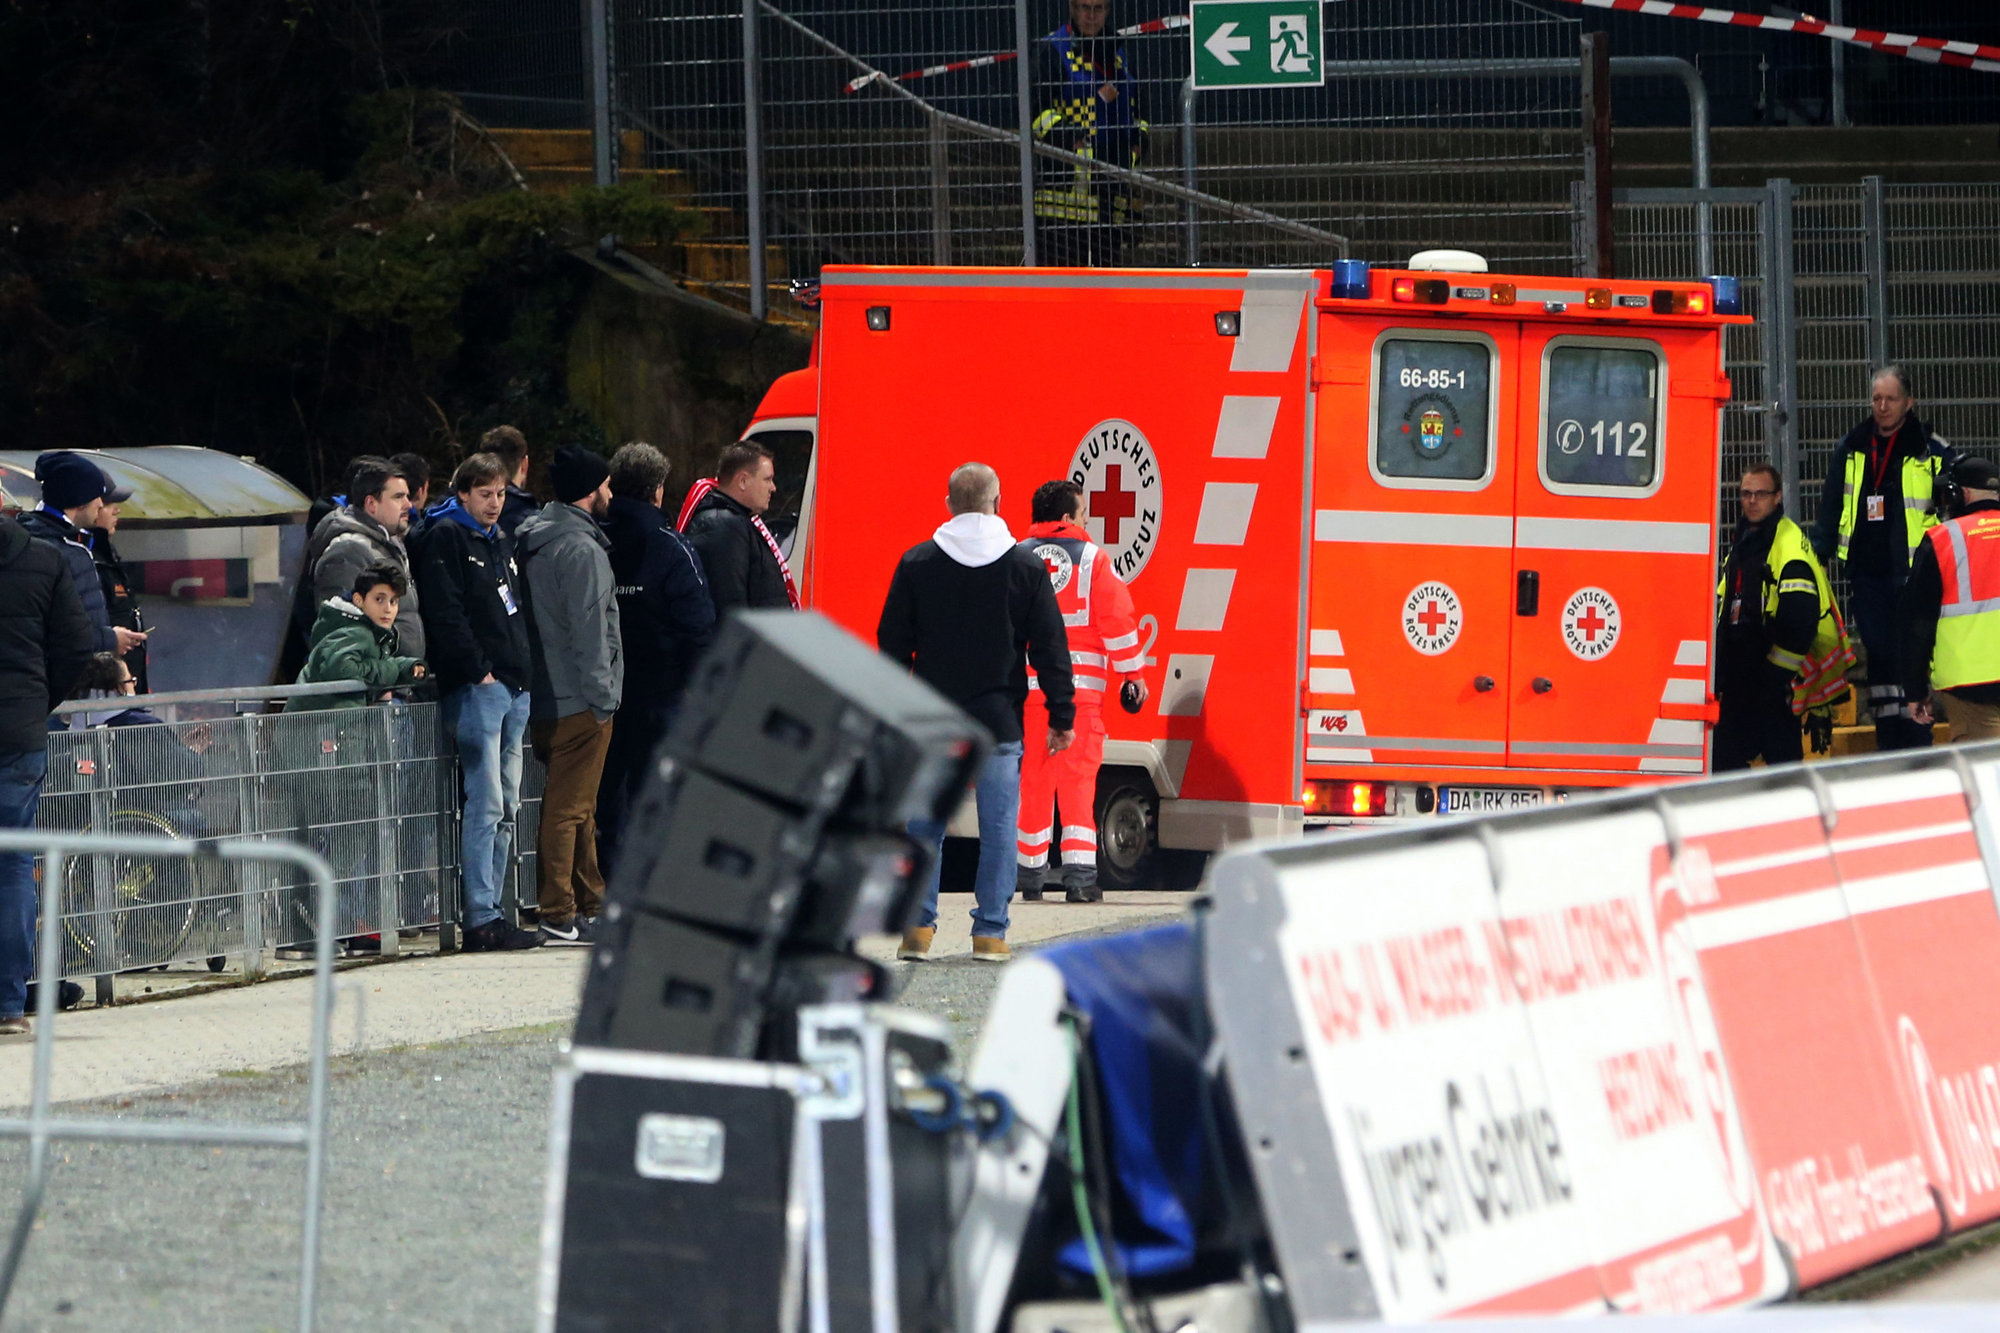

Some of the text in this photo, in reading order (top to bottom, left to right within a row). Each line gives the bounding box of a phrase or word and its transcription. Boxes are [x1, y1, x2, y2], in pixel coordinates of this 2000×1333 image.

[1400, 368, 1465, 389] 66-85-1
[1591, 420, 1648, 458] 112
[1072, 429, 1154, 488] DEUTSCHES
[1113, 508, 1155, 577] KREUZ
[1408, 586, 1457, 611] DEUTSCHES
[1567, 592, 1615, 616] DEUTSCHES
[1406, 618, 1458, 651] ROTES KREUZ
[1565, 624, 1617, 656] ROTES KREUZ
[1450, 791, 1471, 811] DA
[1484, 792, 1505, 811] RK
[1481, 897, 1653, 1006] INSTALLATIONEN
[1597, 1042, 1694, 1140] HEIZUNG
[1346, 1103, 1469, 1300] Jürgen
[1446, 1062, 1574, 1224] Gehrke
